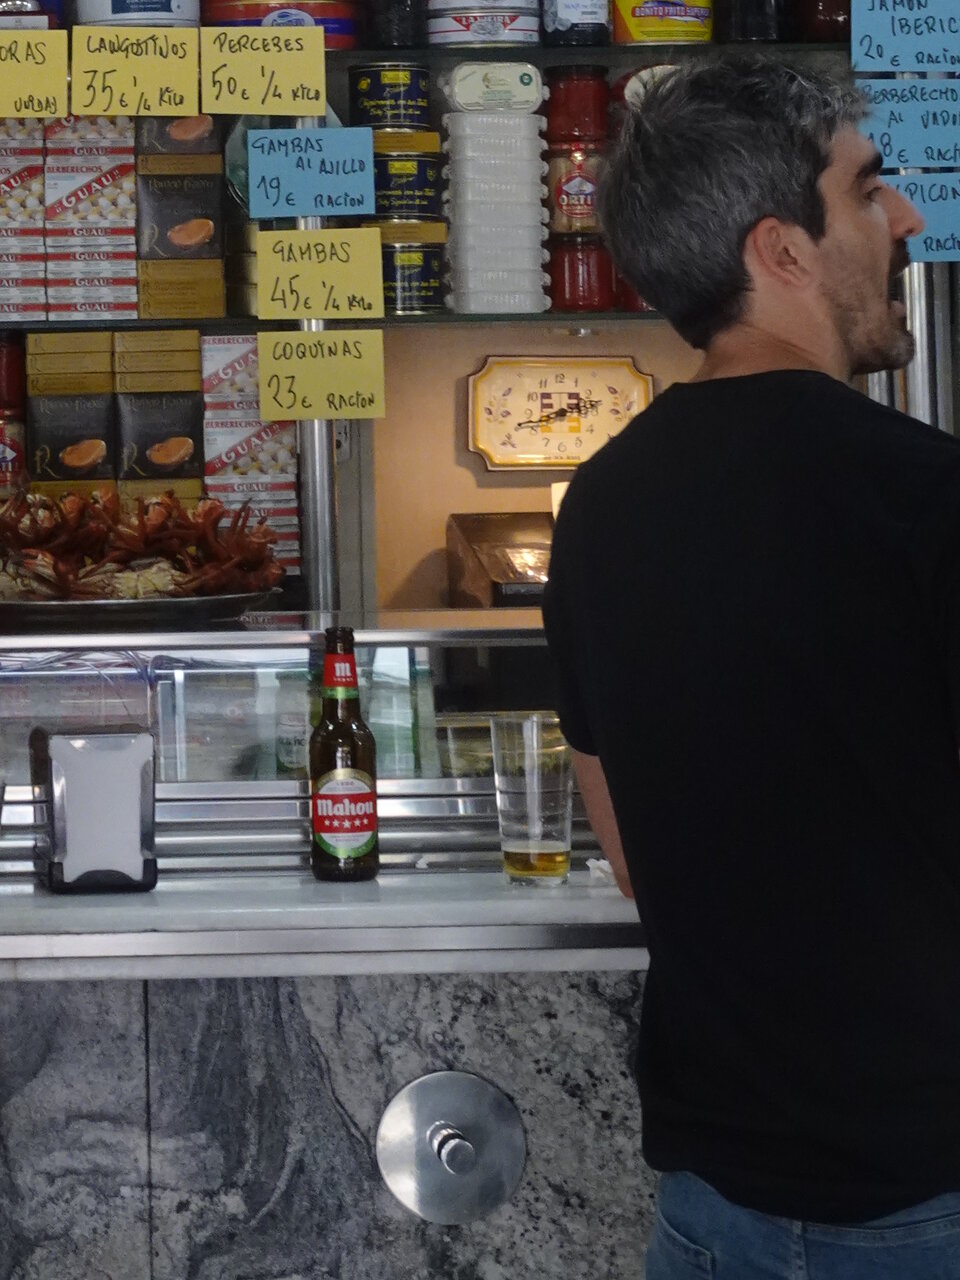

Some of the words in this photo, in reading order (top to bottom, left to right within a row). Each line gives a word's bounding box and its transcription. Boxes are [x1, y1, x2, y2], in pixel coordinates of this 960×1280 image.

[891, 16, 960, 36] IBERIC
[214, 32, 304, 53] PERCEBES
[862, 84, 960, 104] BERBERECHO
[252, 137, 324, 157] GAMBAS
[559, 195, 593, 205] ORTI
[272, 240, 351, 263] GAMBAS
[272, 340, 362, 360] COQUINAS
[317, 798, 373, 816] Mahou
